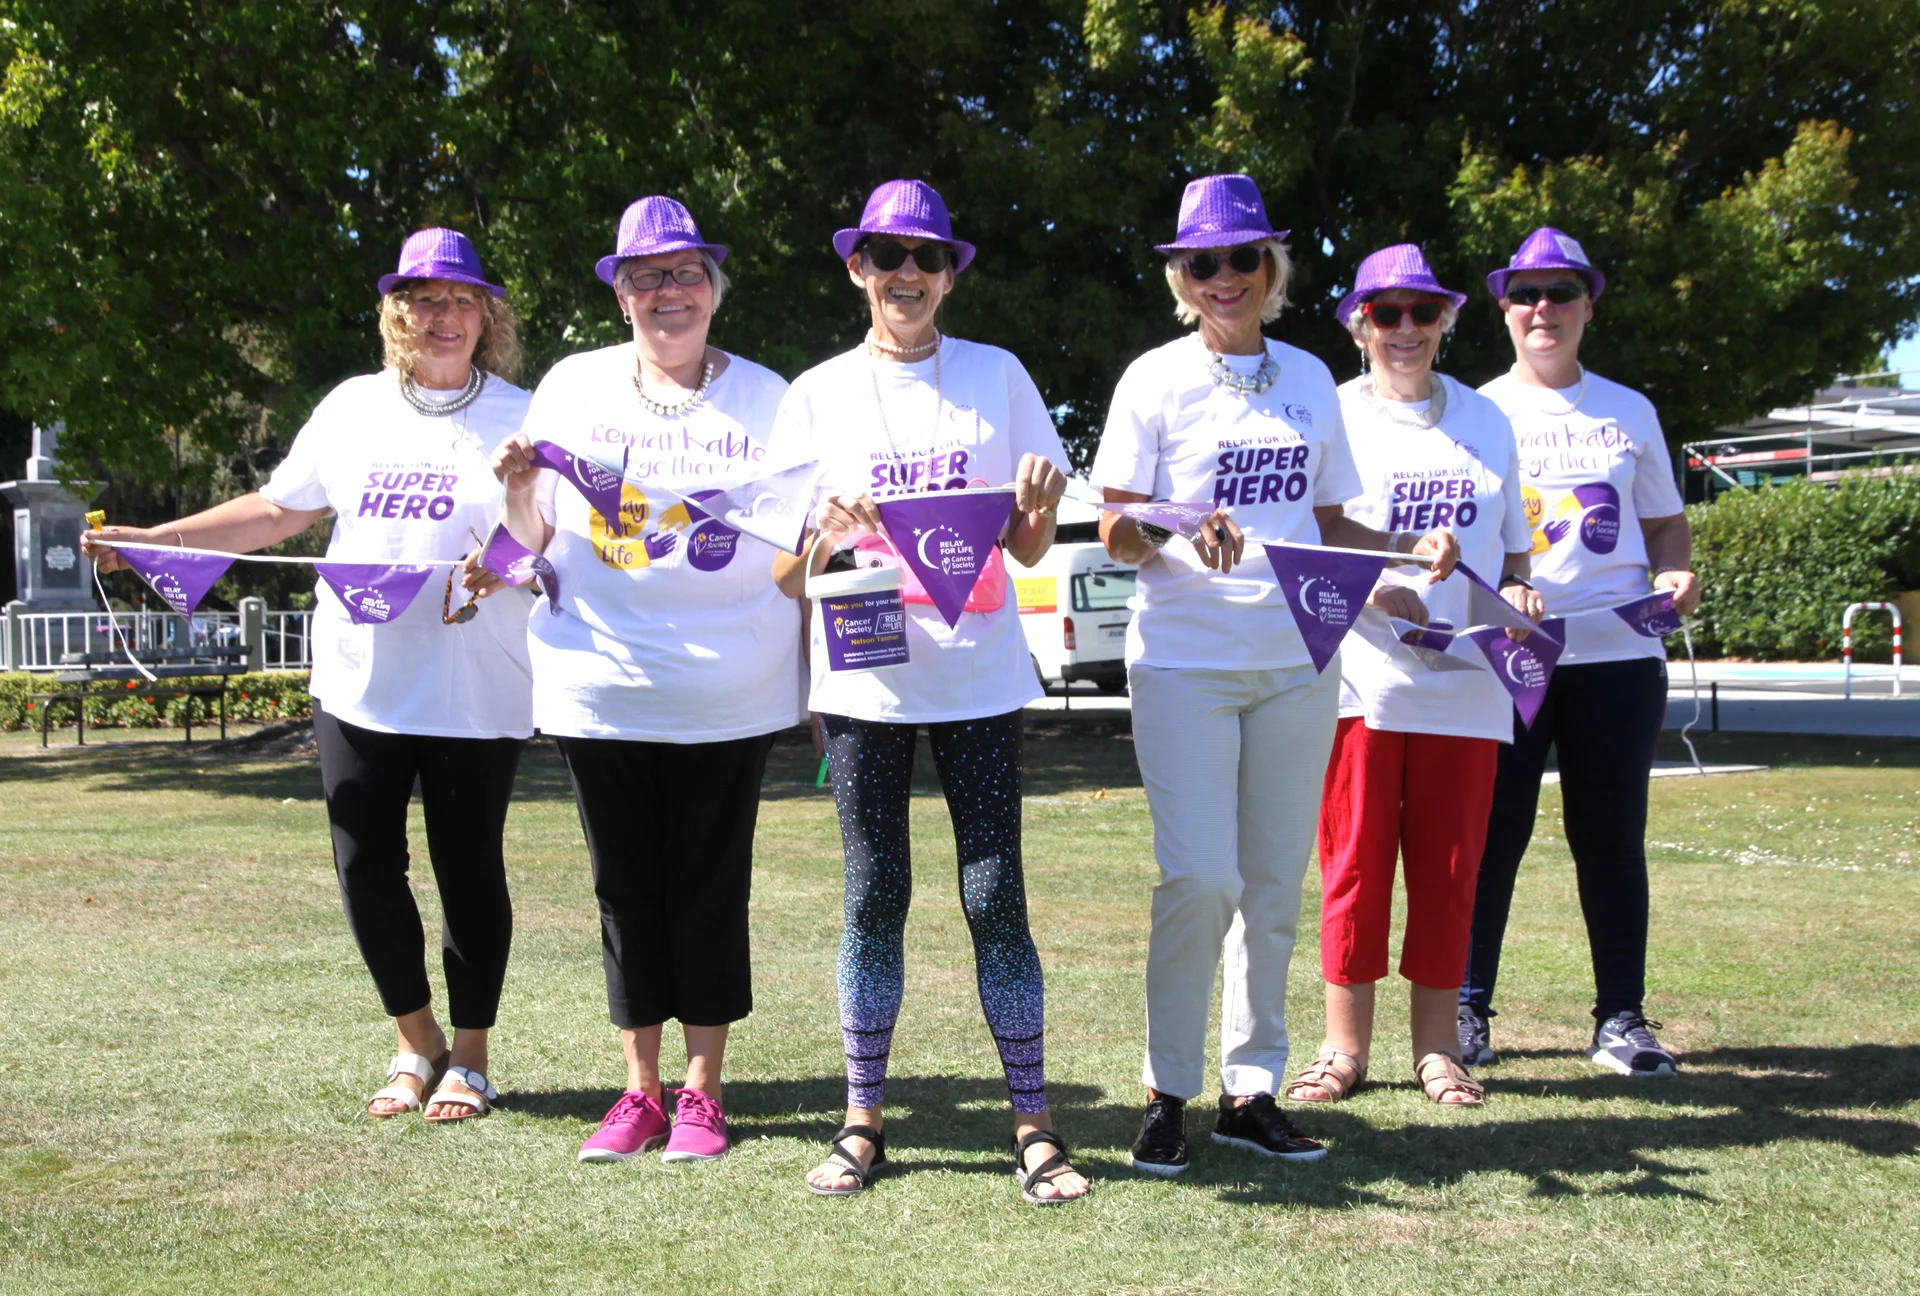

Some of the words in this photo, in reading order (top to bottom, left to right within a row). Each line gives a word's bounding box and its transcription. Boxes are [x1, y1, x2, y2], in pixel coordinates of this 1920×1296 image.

[1218, 438, 1253, 449] RELAY
[1258, 436, 1279, 445] FOR
[1283, 433, 1306, 443] LIFE
[1517, 423, 1635, 453] markable
[1216, 445, 1309, 476] SUPER
[871, 450, 969, 488] SUPER
[1393, 471, 1424, 480] RELAY
[1429, 469, 1448, 477] FOR
[1452, 468, 1470, 477] LIFE
[364, 471, 459, 492] SUPER
[1213, 471, 1307, 509] HERO
[1392, 479, 1475, 504] SUPER
[357, 492, 455, 521] HERO
[1389, 501, 1477, 532] HERO
[708, 533, 735, 542] Cancer
[706, 540, 731, 550] Society
[939, 540, 964, 549] RELAY
[940, 547, 956, 555] FOR
[957, 546, 973, 554] LIFE
[601, 544, 633, 565] Life
[163, 586, 181, 594] RELAY
[1318, 591, 1340, 599] RELAY
[830, 603, 849, 611] Thank
[851, 602, 864, 610] you
[876, 599, 890, 607] your
[844, 618, 872, 627] Cancer
[885, 613, 903, 623] RELAY
[1327, 612, 1348, 621] Society
[845, 625, 872, 635] Society
[891, 621, 903, 631] LIFE
